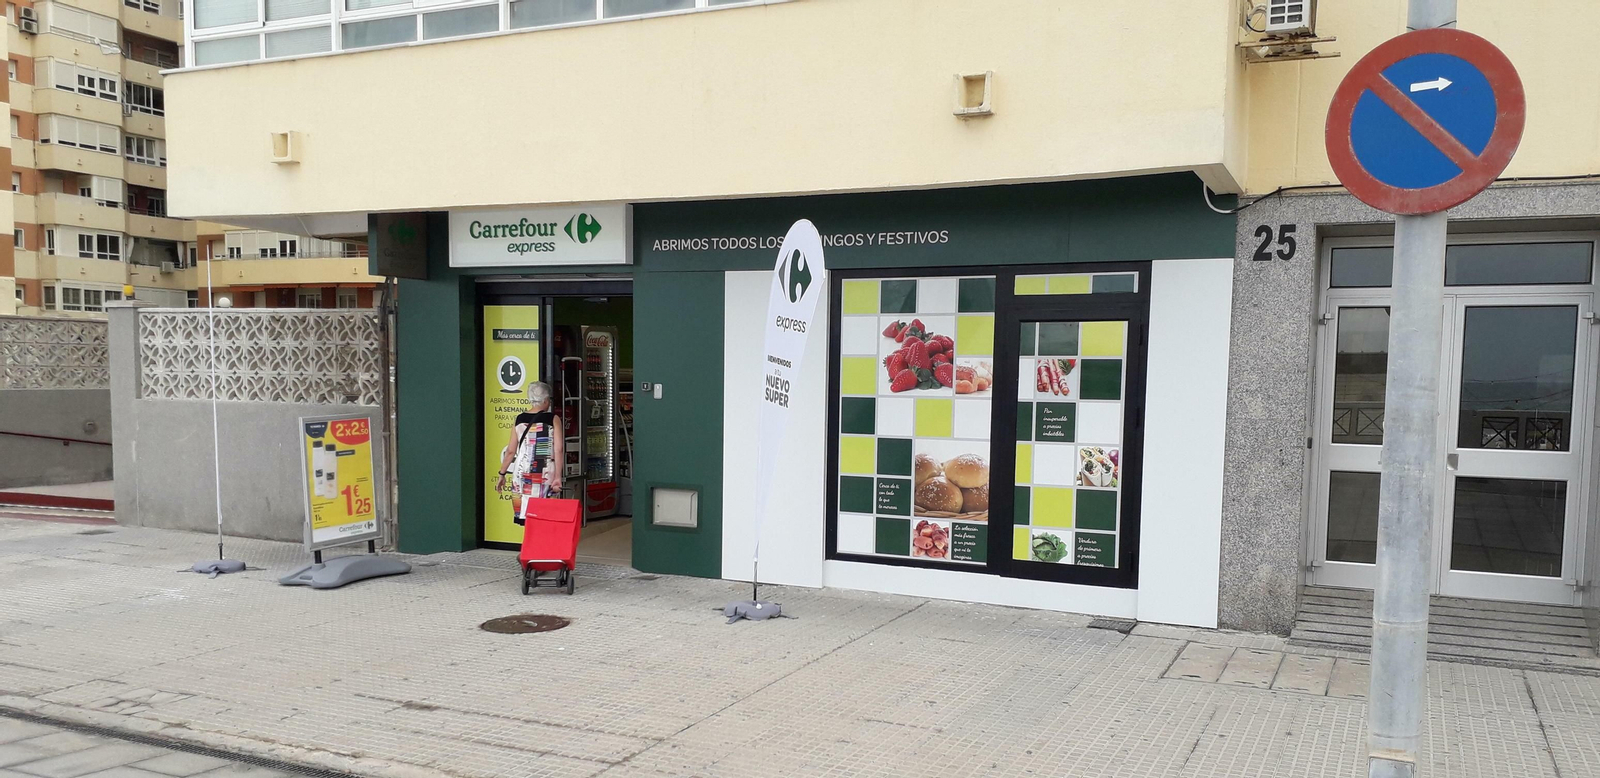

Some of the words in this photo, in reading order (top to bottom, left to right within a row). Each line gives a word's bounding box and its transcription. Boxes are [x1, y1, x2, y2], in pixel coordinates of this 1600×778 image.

[469, 217, 558, 240] Carrefour
[506, 240, 556, 256] express
[652, 238, 709, 251] ABRIMOS
[711, 236, 757, 250] TODOS
[820, 233, 864, 247] INGOS
[866, 232, 876, 246] Y
[878, 230, 949, 245] FESTIVOS
[1252, 224, 1297, 262] 25
[775, 315, 807, 333] express
[523, 330, 530, 339] de
[767, 354, 792, 368] BIENVENIDOS
[765, 373, 790, 394] NUEVO
[489, 397, 515, 405] ABRIMOS
[764, 387, 789, 408] SUPER
